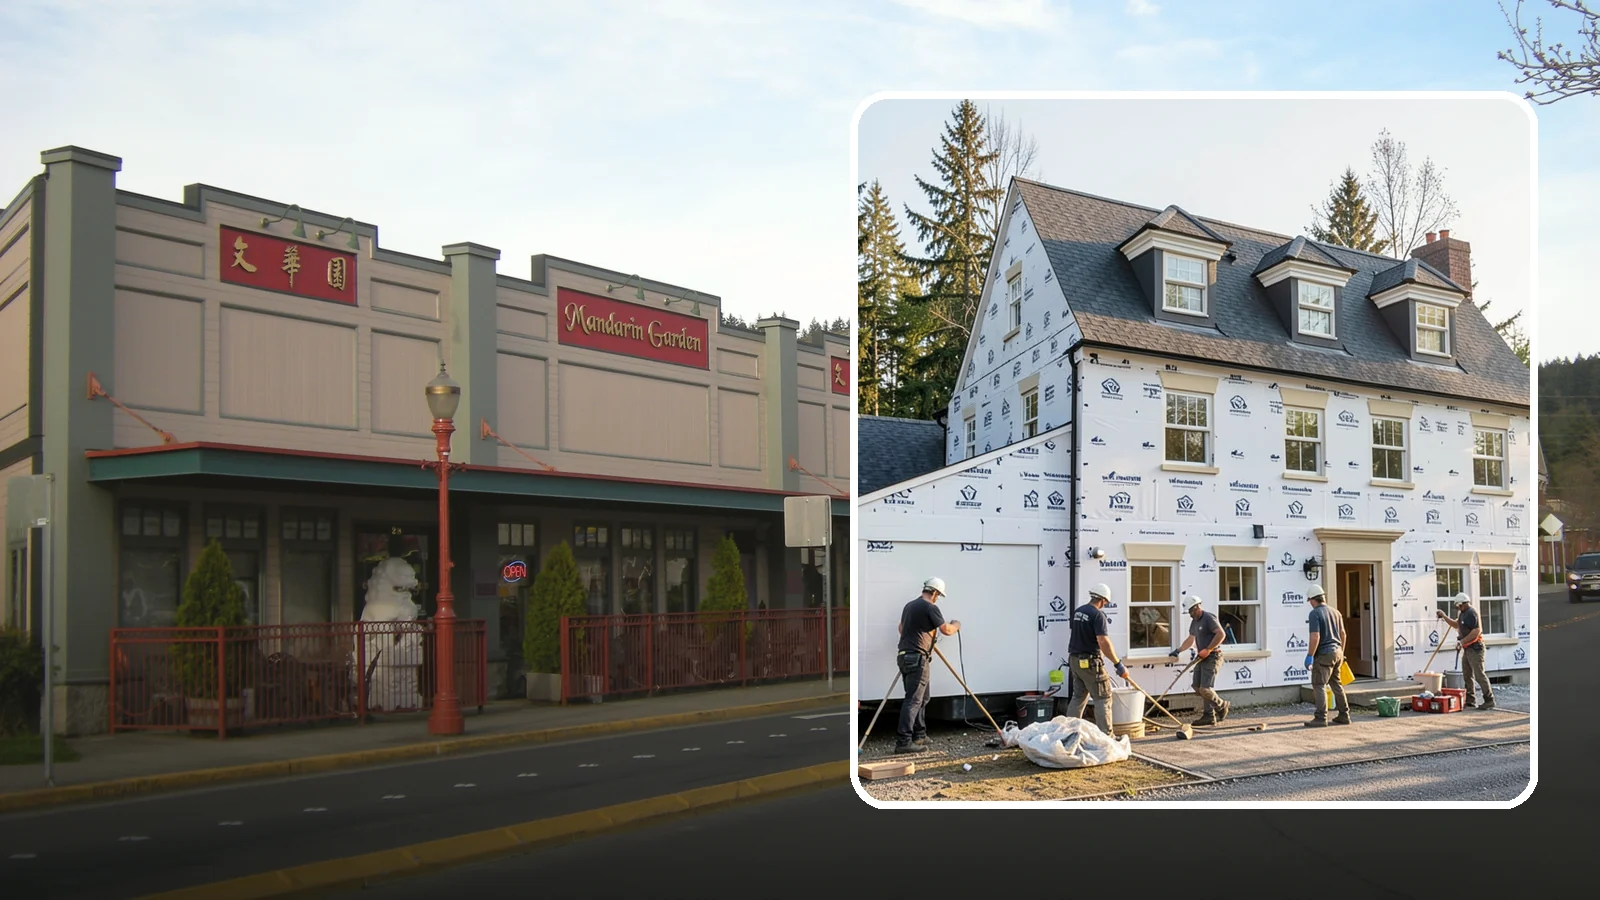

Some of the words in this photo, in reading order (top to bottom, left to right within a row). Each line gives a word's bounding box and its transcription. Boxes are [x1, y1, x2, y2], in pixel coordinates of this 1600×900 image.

[231, 236, 346, 290] 文華園
[564, 302, 645, 341] Mandarin
[648, 320, 702, 352] Garden
[502, 565, 527, 579] OPEN
